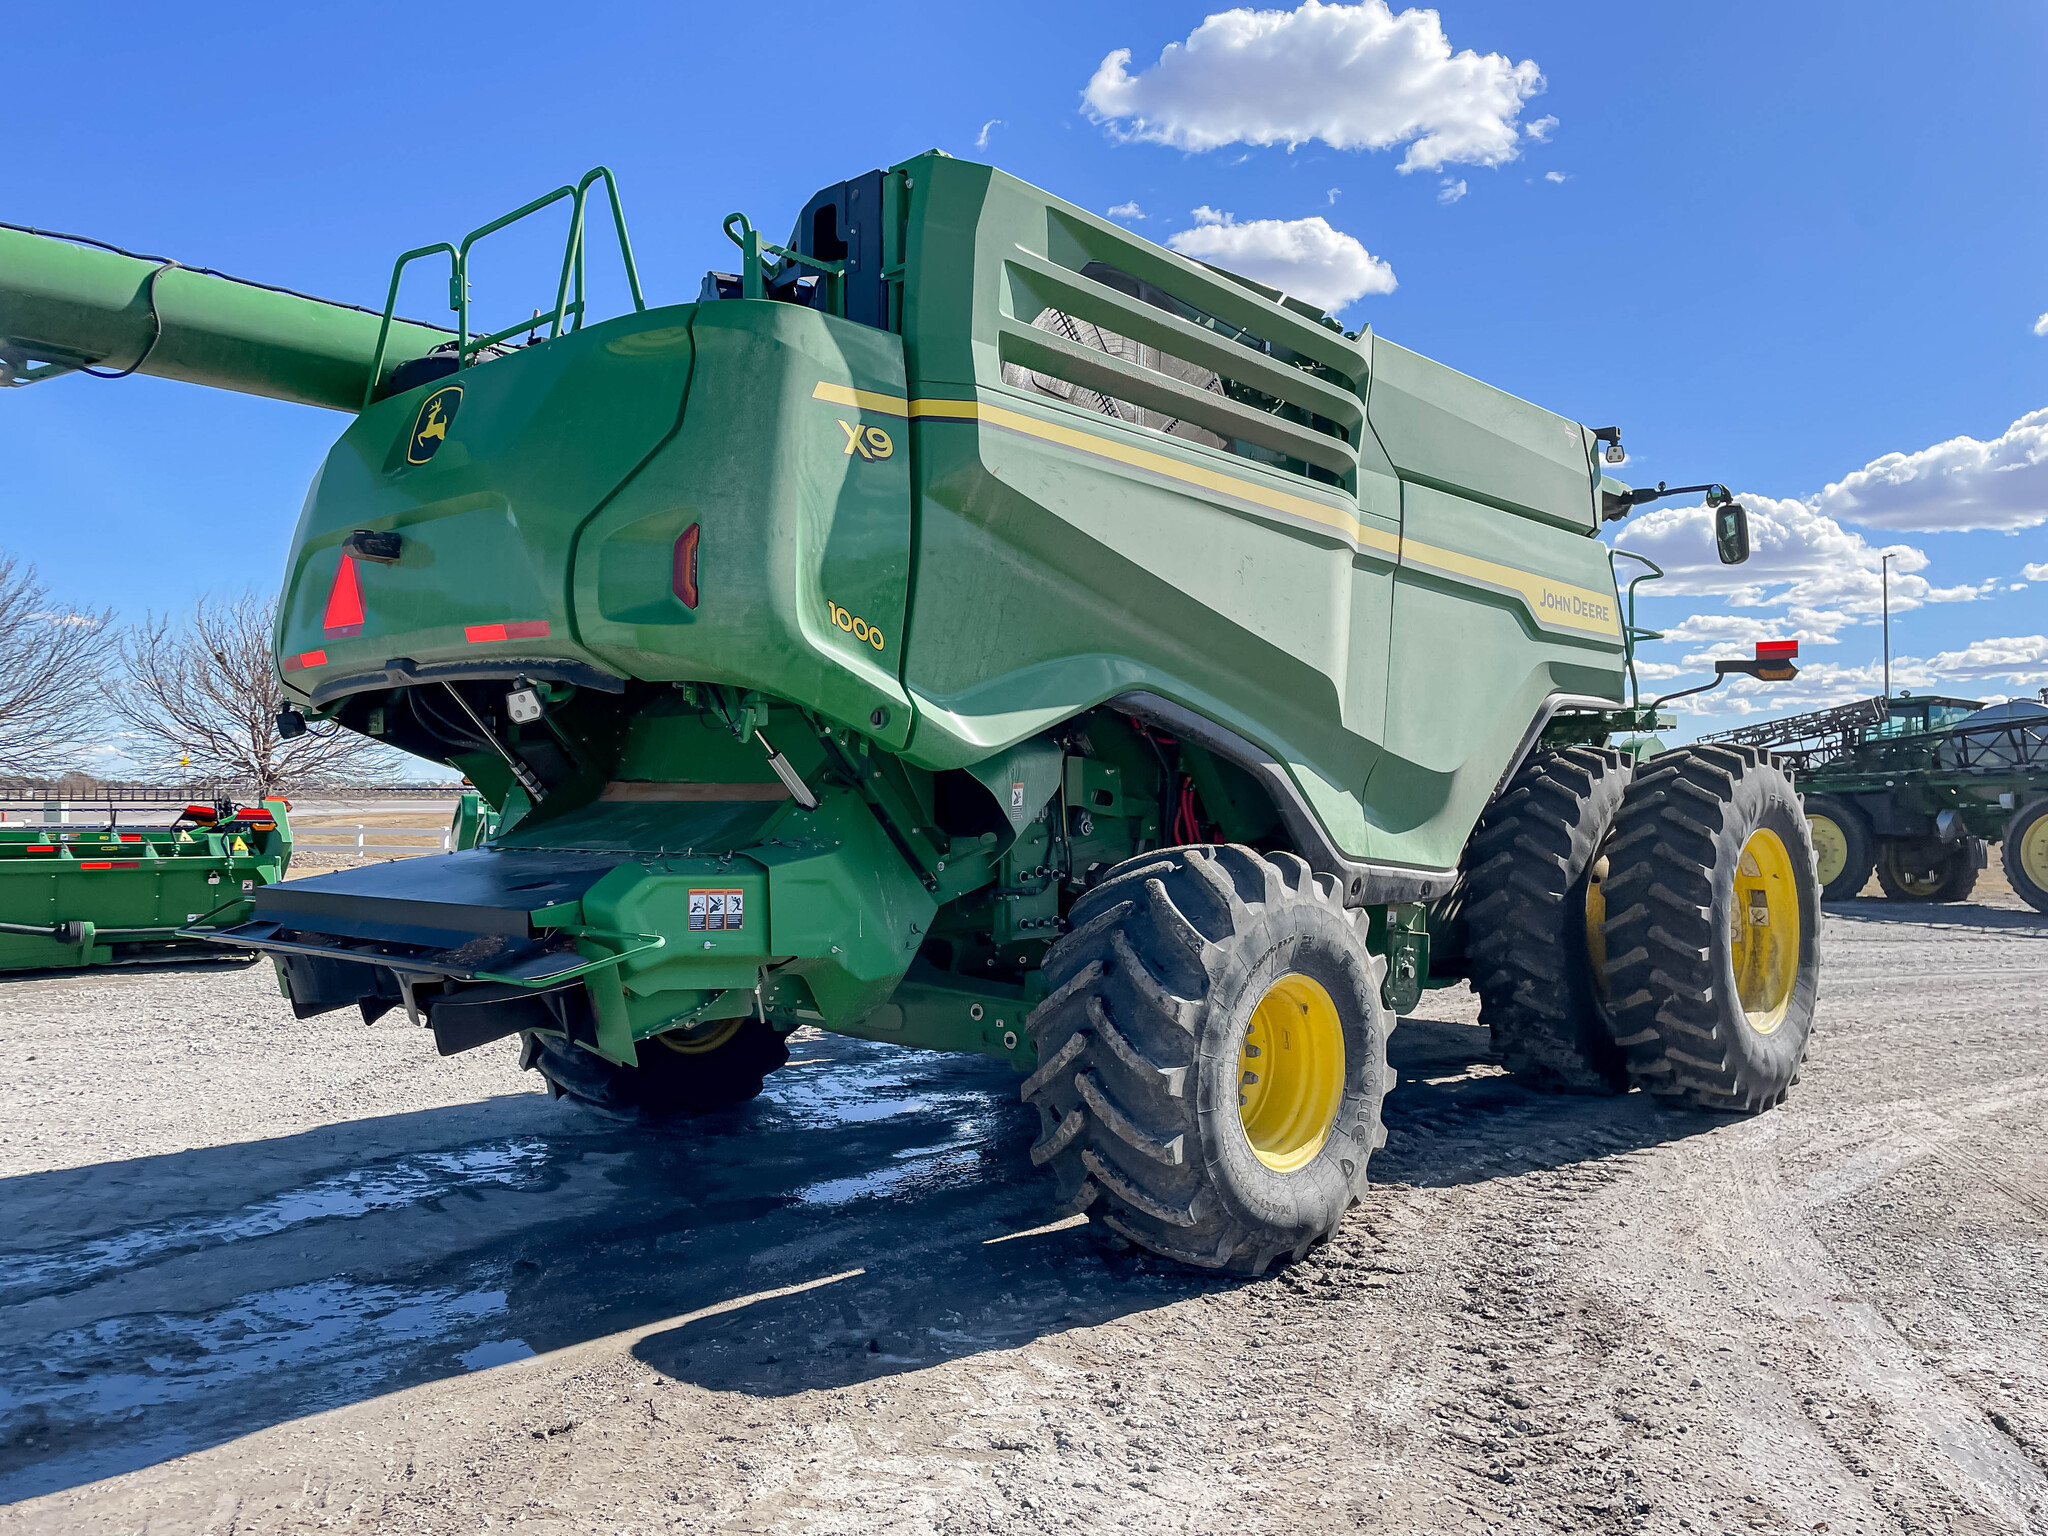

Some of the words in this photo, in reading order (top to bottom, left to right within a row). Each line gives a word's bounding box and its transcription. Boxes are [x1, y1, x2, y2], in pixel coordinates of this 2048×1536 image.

[837, 418, 894, 462] X9
[827, 599, 885, 651] 1000
[1539, 588, 1571, 613] JOHN
[1572, 595, 1610, 621] DEERE
